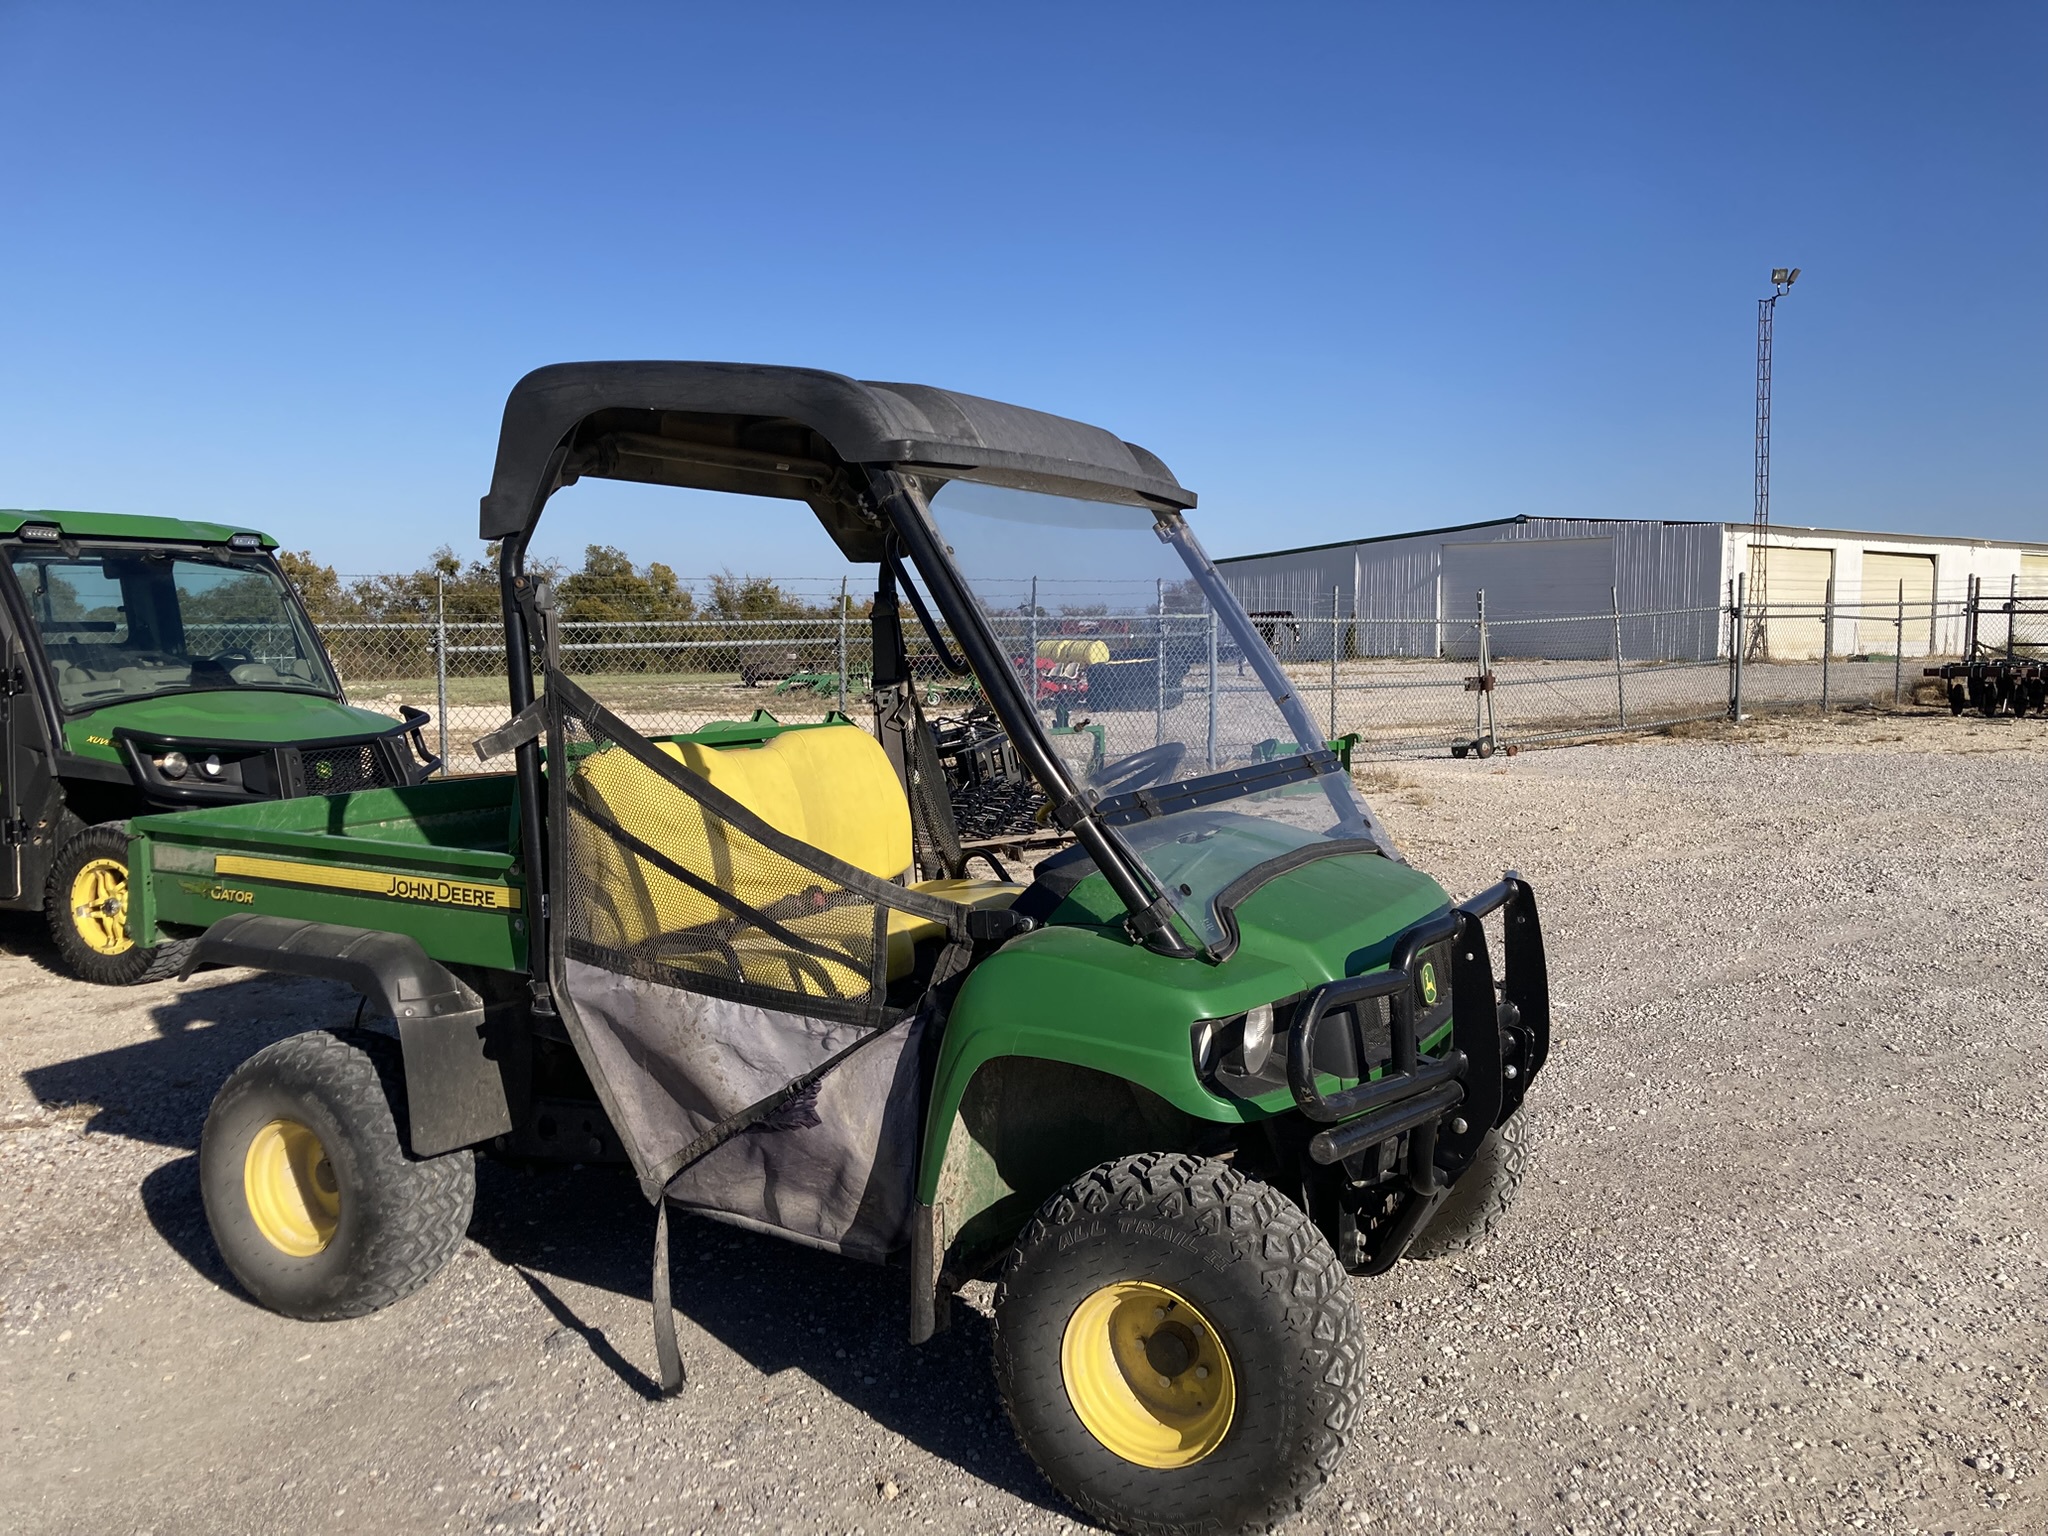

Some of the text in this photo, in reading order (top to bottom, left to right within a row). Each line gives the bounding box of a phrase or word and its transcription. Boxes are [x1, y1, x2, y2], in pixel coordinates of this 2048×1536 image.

[210, 885, 254, 904] GATOR
[386, 876, 497, 908] JOHN DEERE
[1059, 1220, 1107, 1251] ALL
[1118, 1217, 1199, 1254] TRAIL
